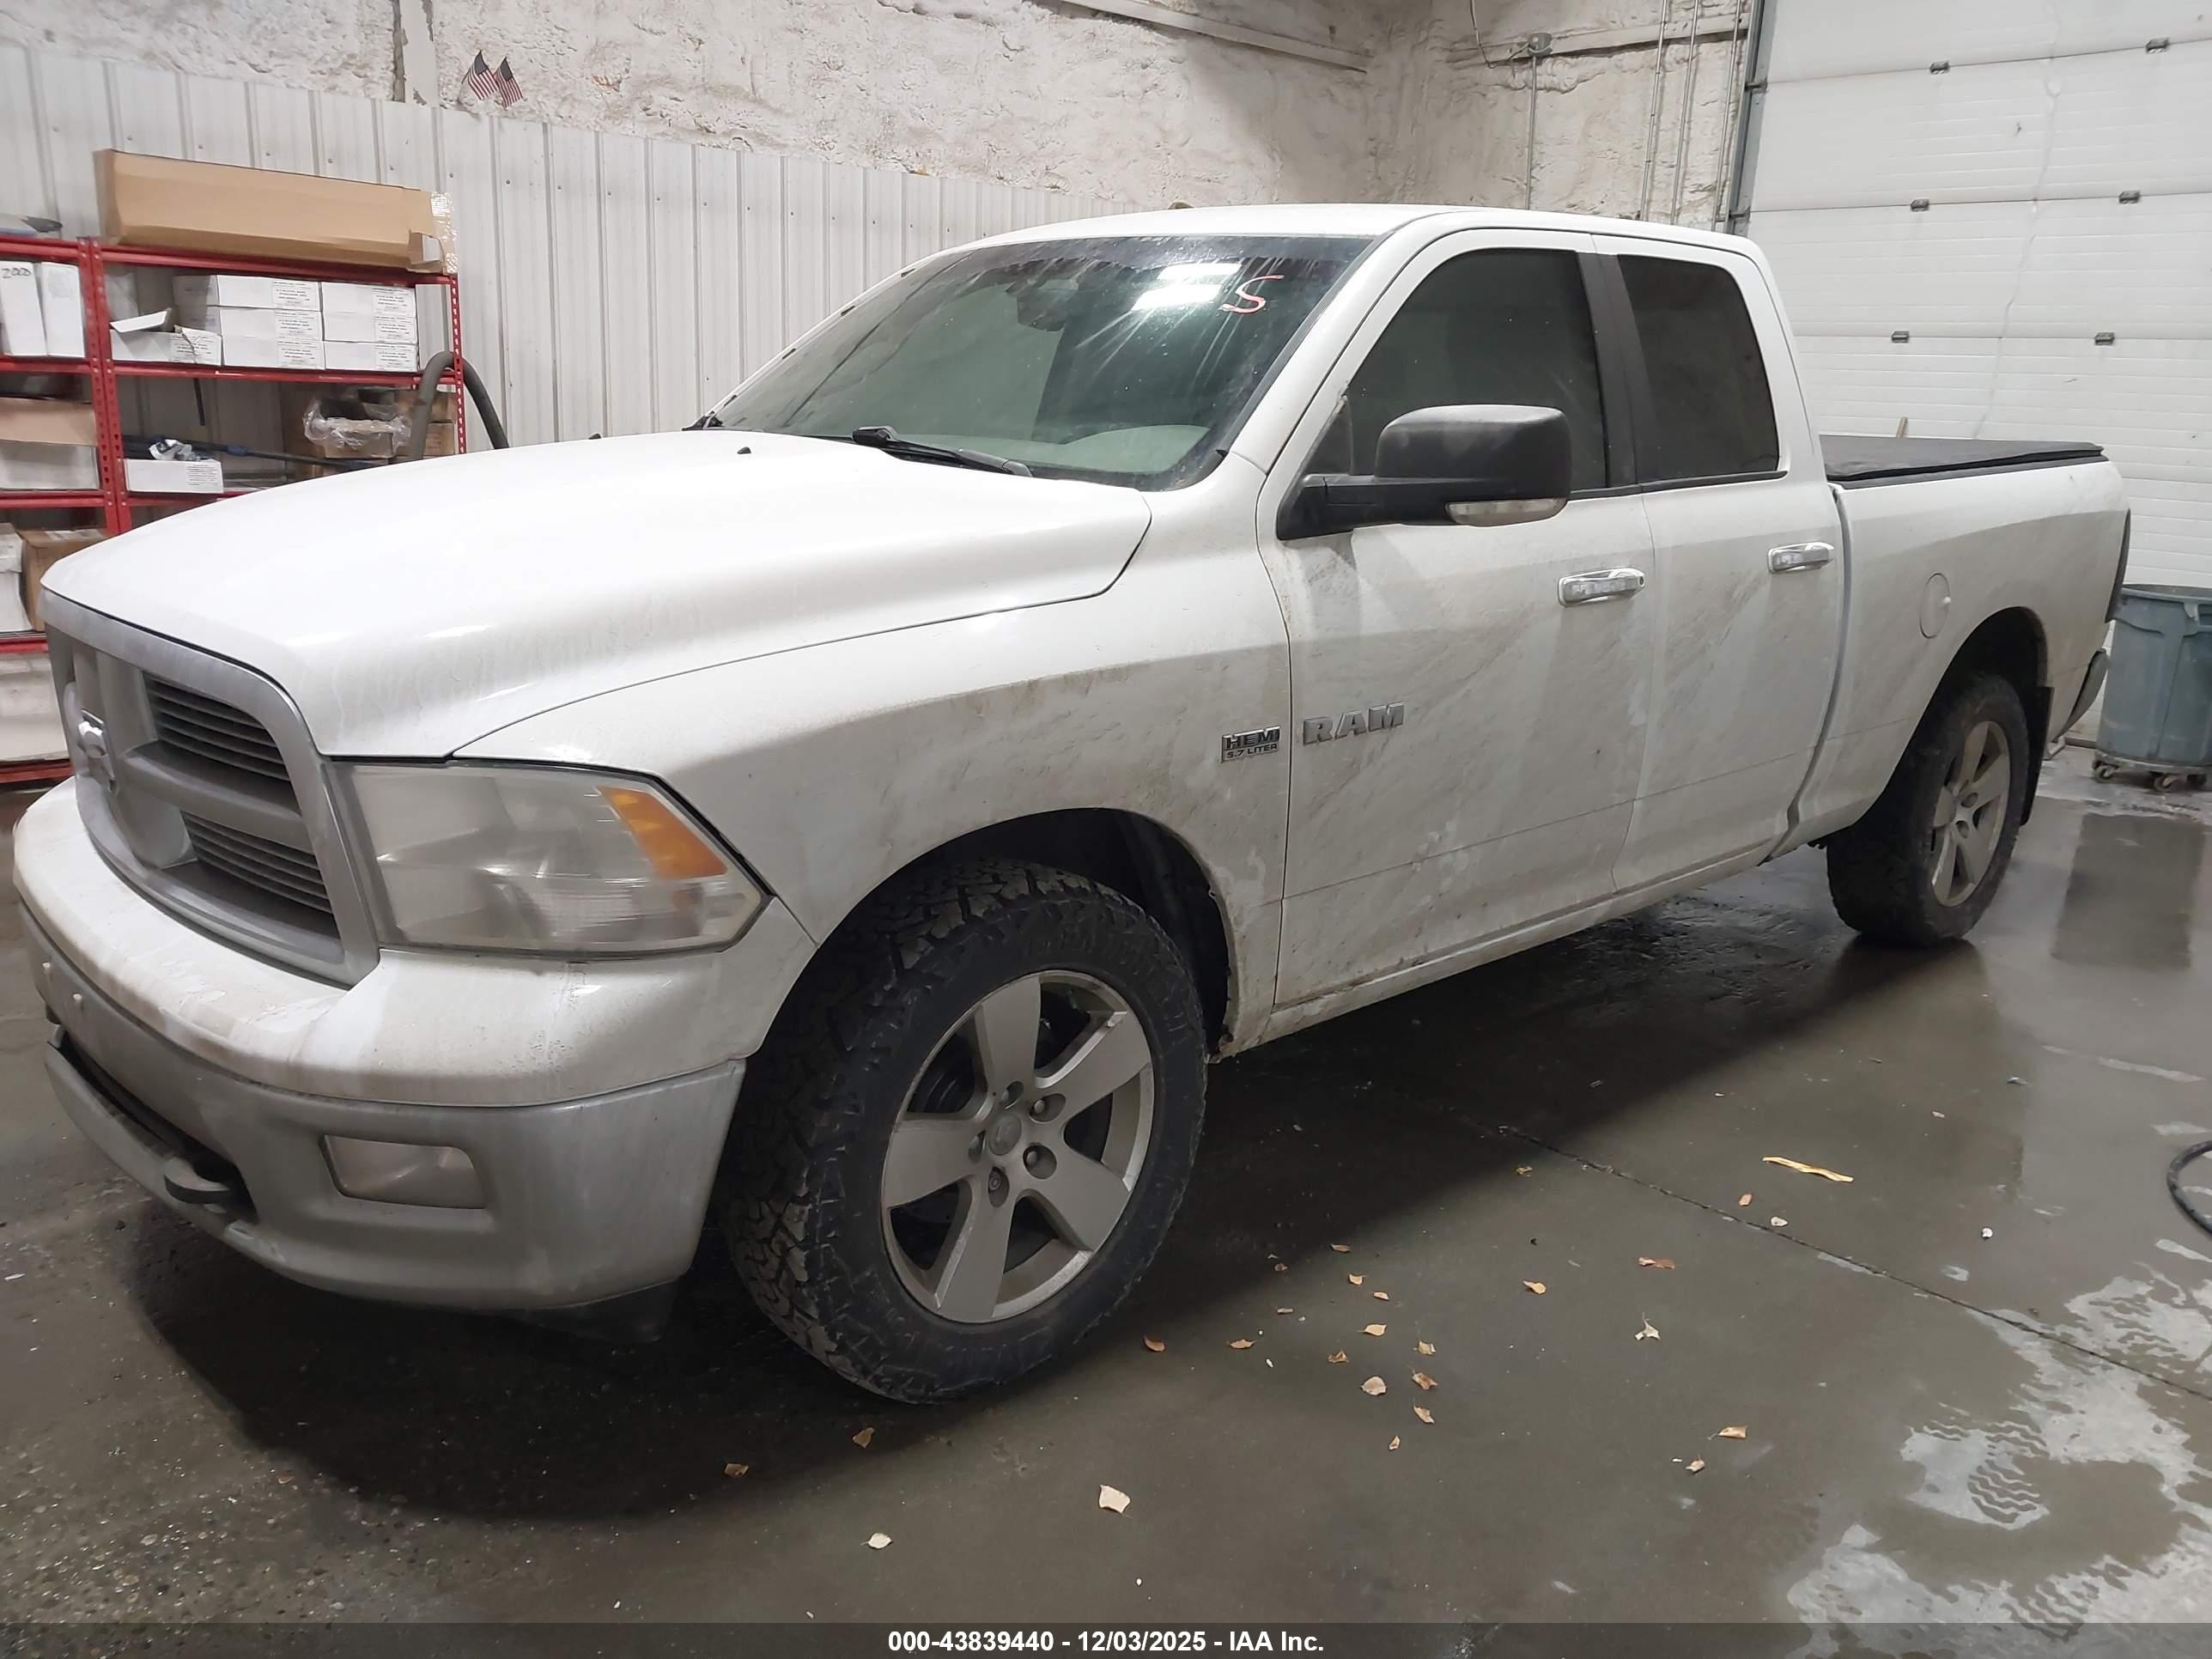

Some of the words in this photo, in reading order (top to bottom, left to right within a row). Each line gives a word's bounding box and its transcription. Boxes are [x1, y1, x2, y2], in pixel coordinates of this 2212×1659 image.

[1304, 701, 1405, 746] RAM
[1222, 726, 1280, 750] HEMI
[1227, 749, 1244, 758] 5.7
[1247, 743, 1278, 755] LITER
